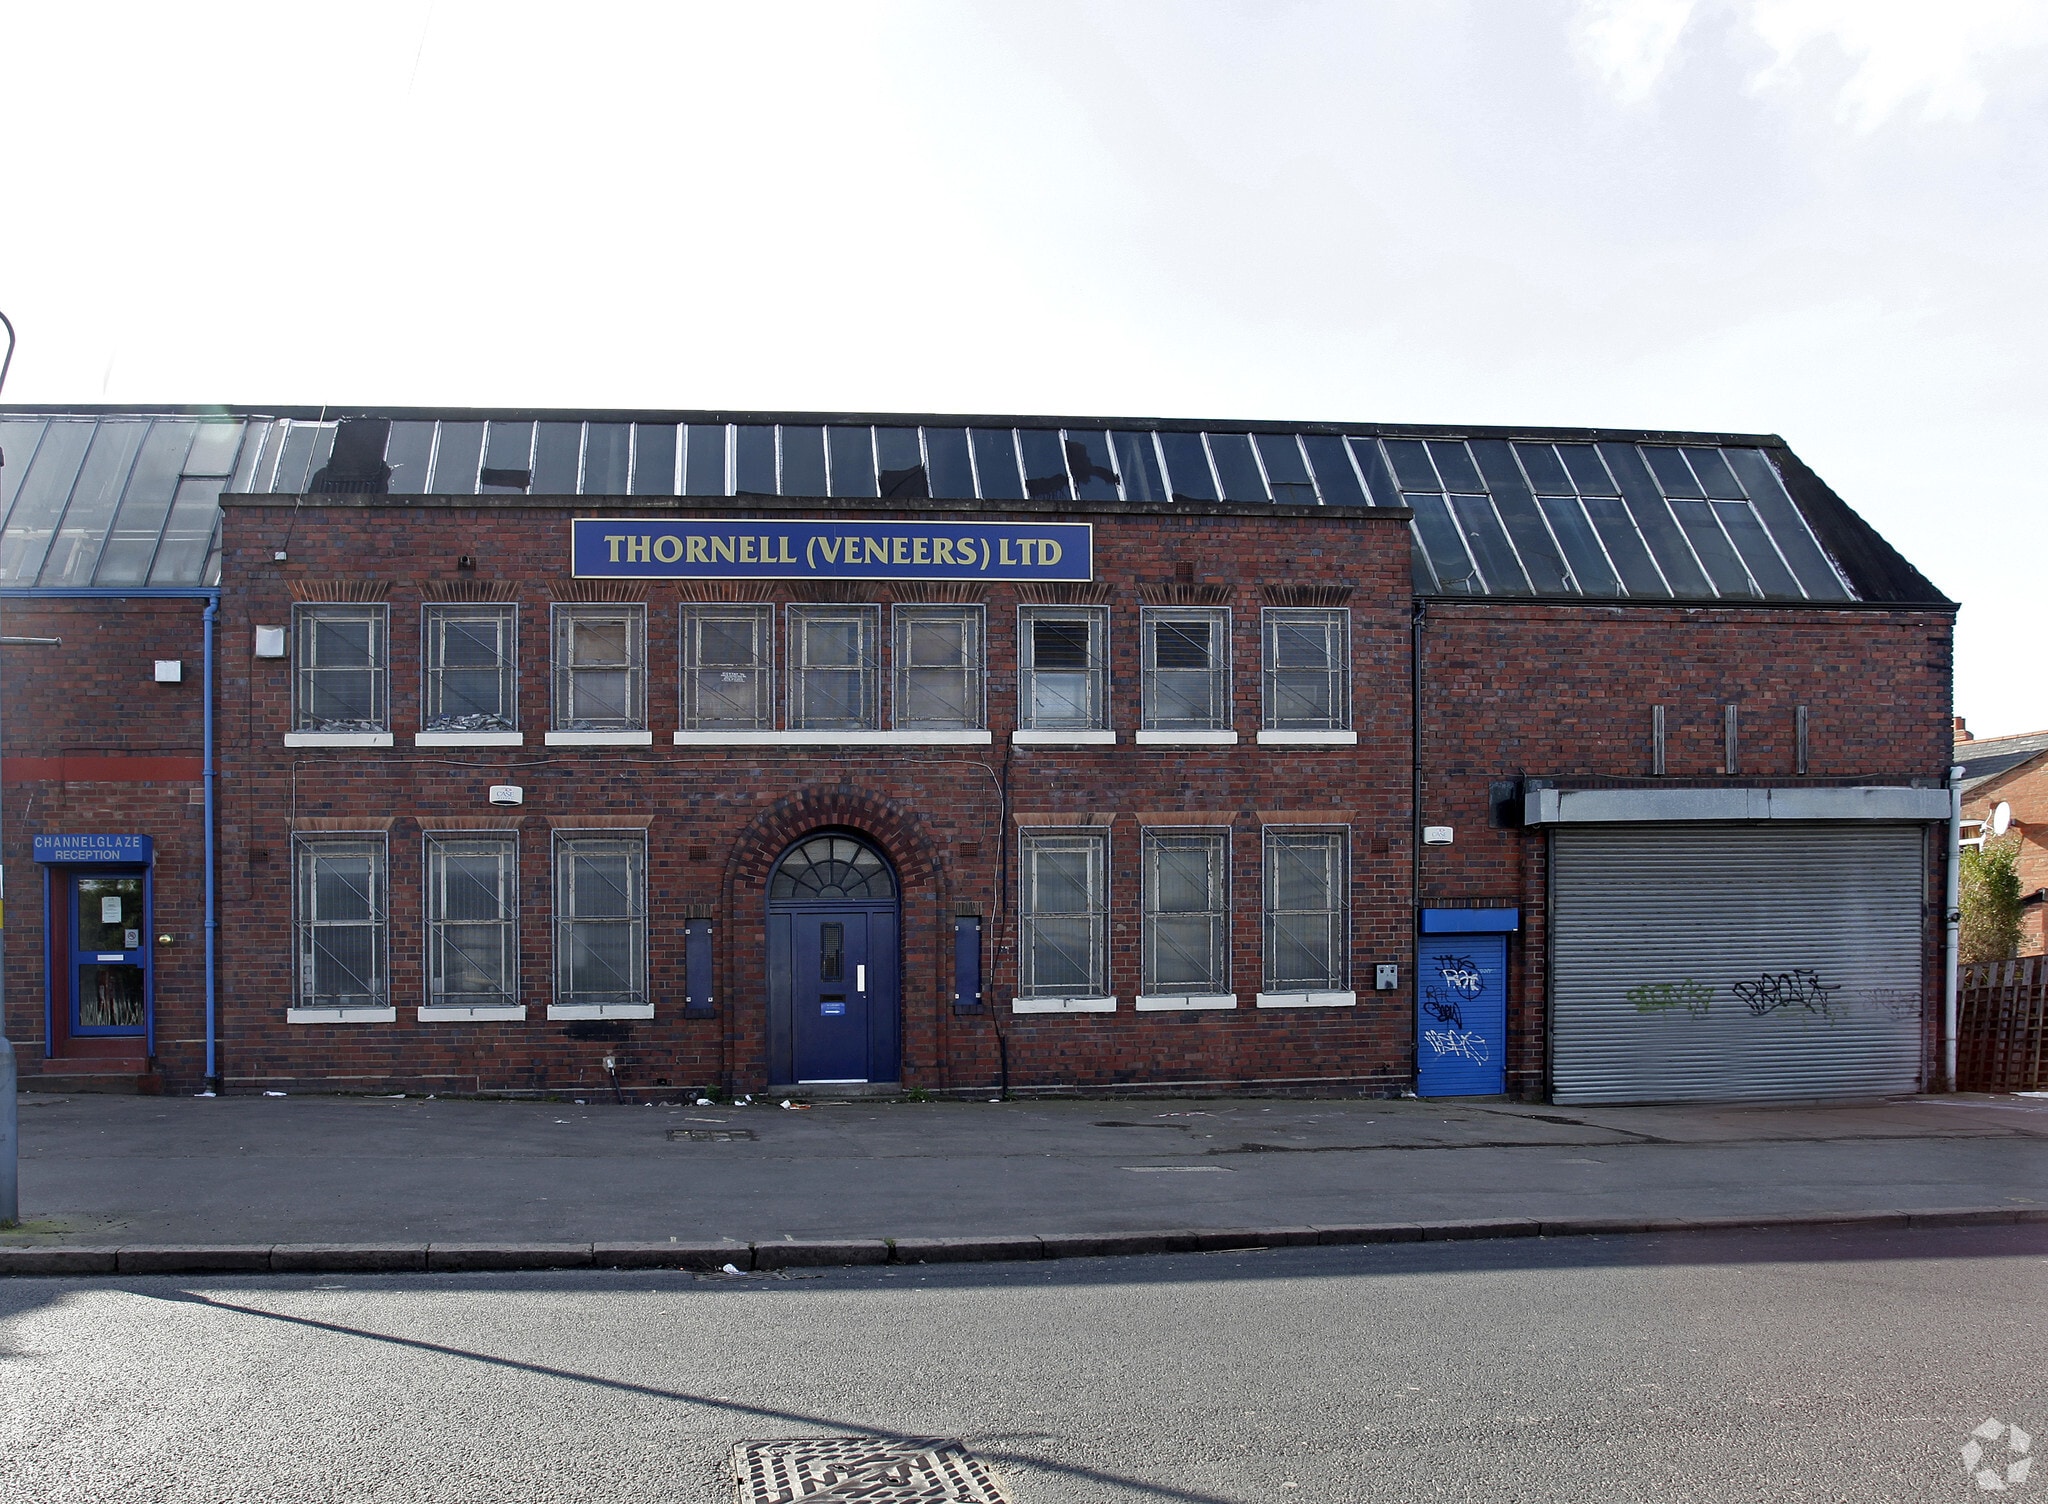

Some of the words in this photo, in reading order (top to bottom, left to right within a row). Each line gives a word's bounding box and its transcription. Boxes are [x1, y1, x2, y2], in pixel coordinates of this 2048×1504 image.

[603, 534, 798, 564] THORNELL
[805, 535, 992, 571] (VENEERS)
[998, 537, 1063, 567] LTD
[34, 836, 140, 848] CHANNELGLAZE
[55, 849, 120, 860] RECEPTION
